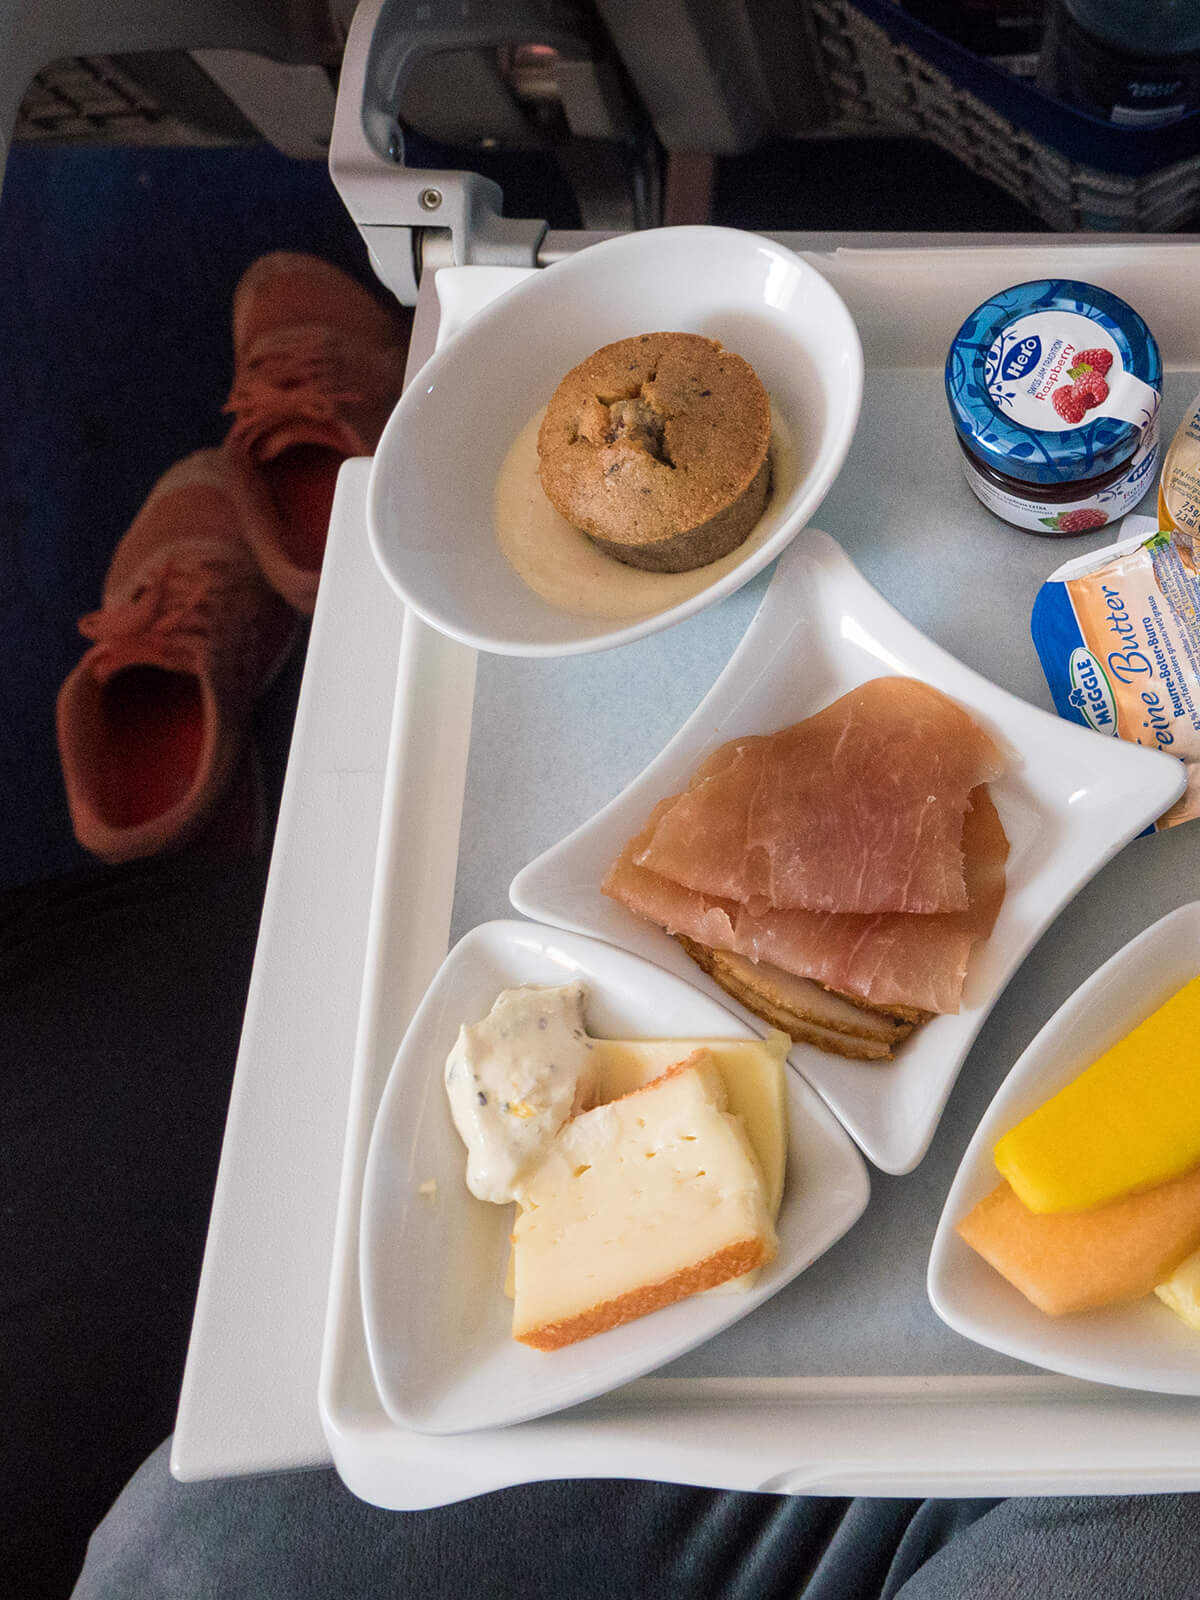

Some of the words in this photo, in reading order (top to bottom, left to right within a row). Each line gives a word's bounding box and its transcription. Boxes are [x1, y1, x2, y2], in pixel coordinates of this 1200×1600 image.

[1006, 339, 1037, 378] Hero
[1035, 343, 1076, 401] Raspberry
[1101, 585, 1153, 684] Butter
[1076, 658, 1113, 726] MEGGLE
